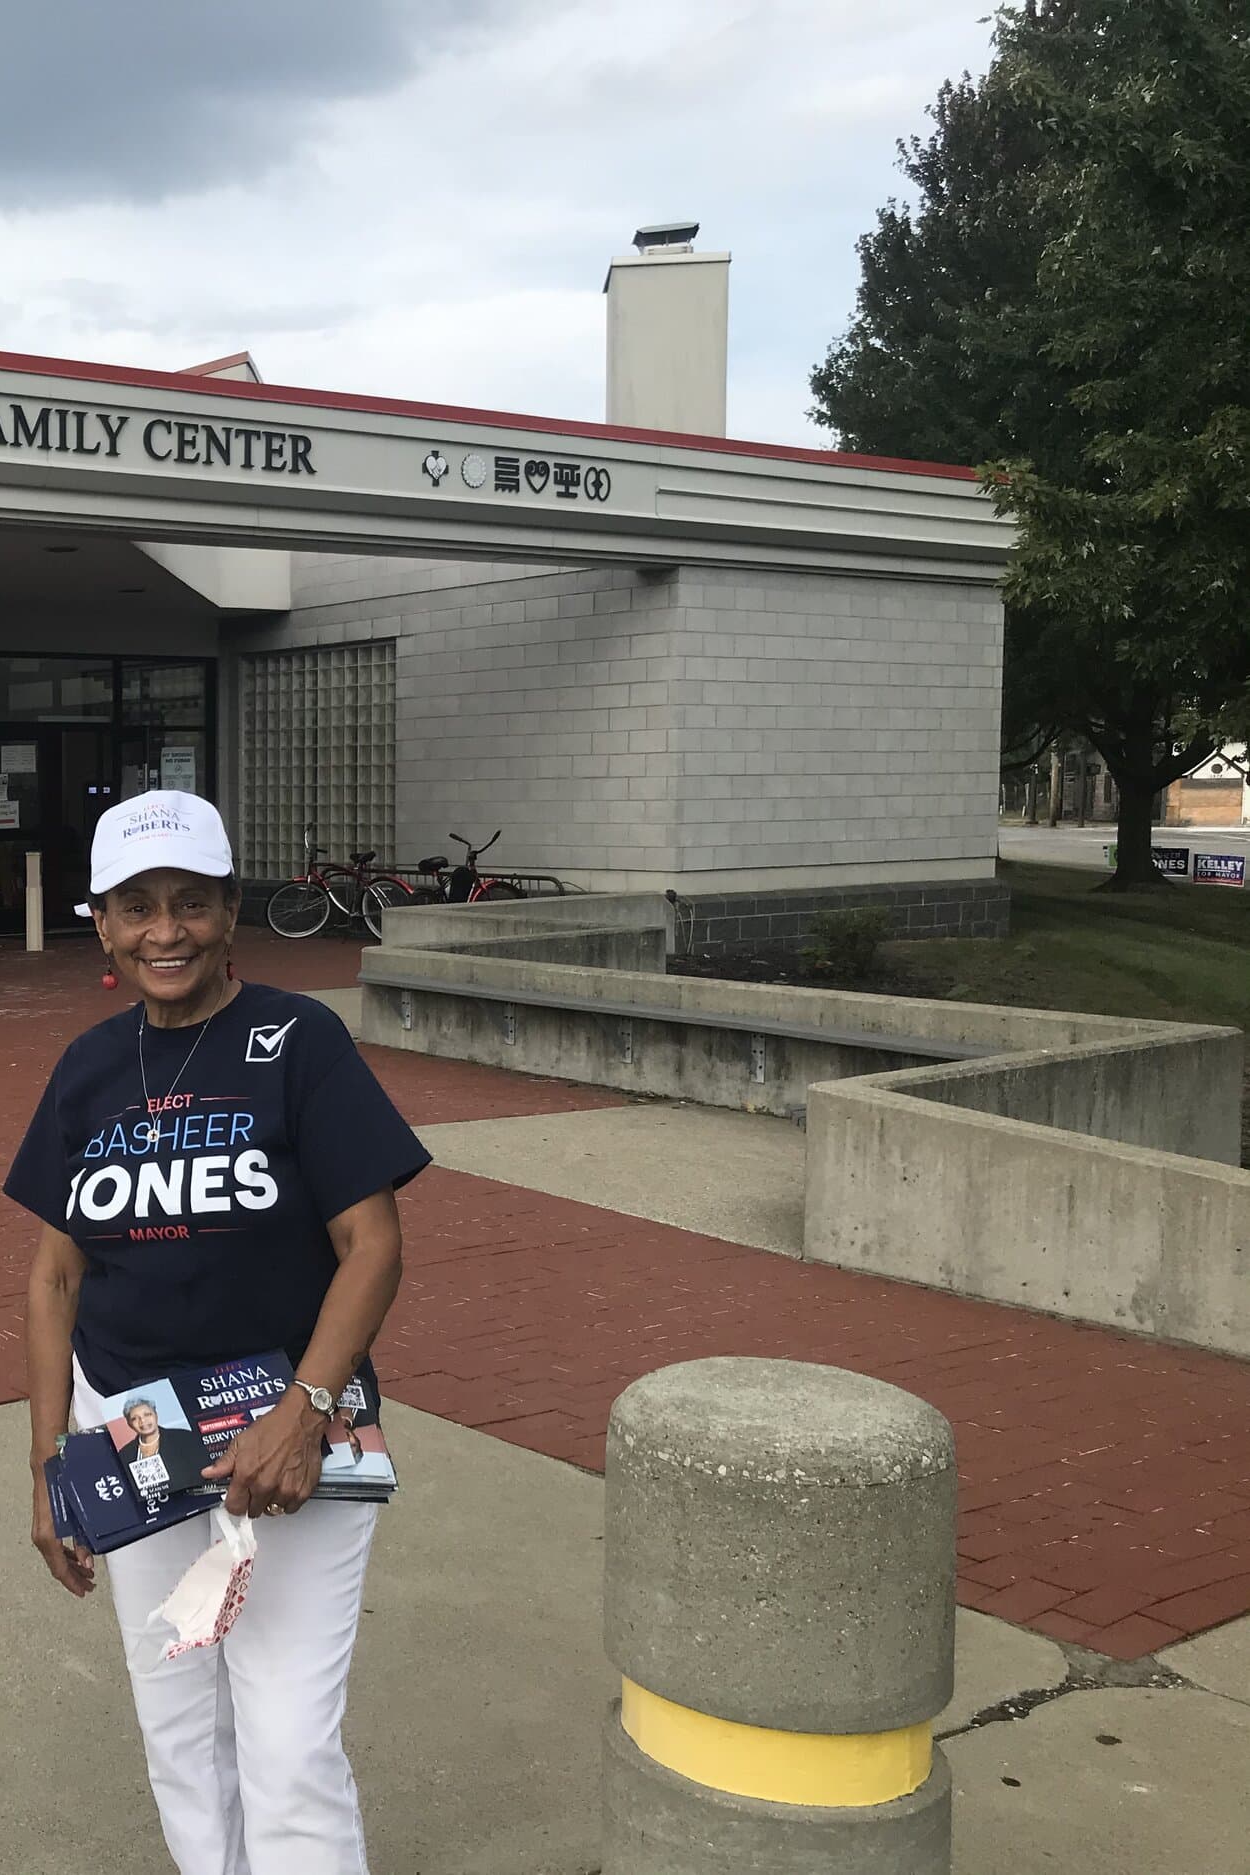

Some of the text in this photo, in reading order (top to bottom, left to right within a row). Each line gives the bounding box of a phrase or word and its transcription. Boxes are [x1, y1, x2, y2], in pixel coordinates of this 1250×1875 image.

[142, 417, 318, 475] CENTER
[129, 808, 180, 825] SHANA
[1197, 859, 1244, 872] KELLEY
[147, 1094, 194, 1113] ELECT
[84, 1113, 254, 1159] BASHEER
[129, 1225, 190, 1242] MAYOR
[200, 1365, 269, 1392] SHANA
